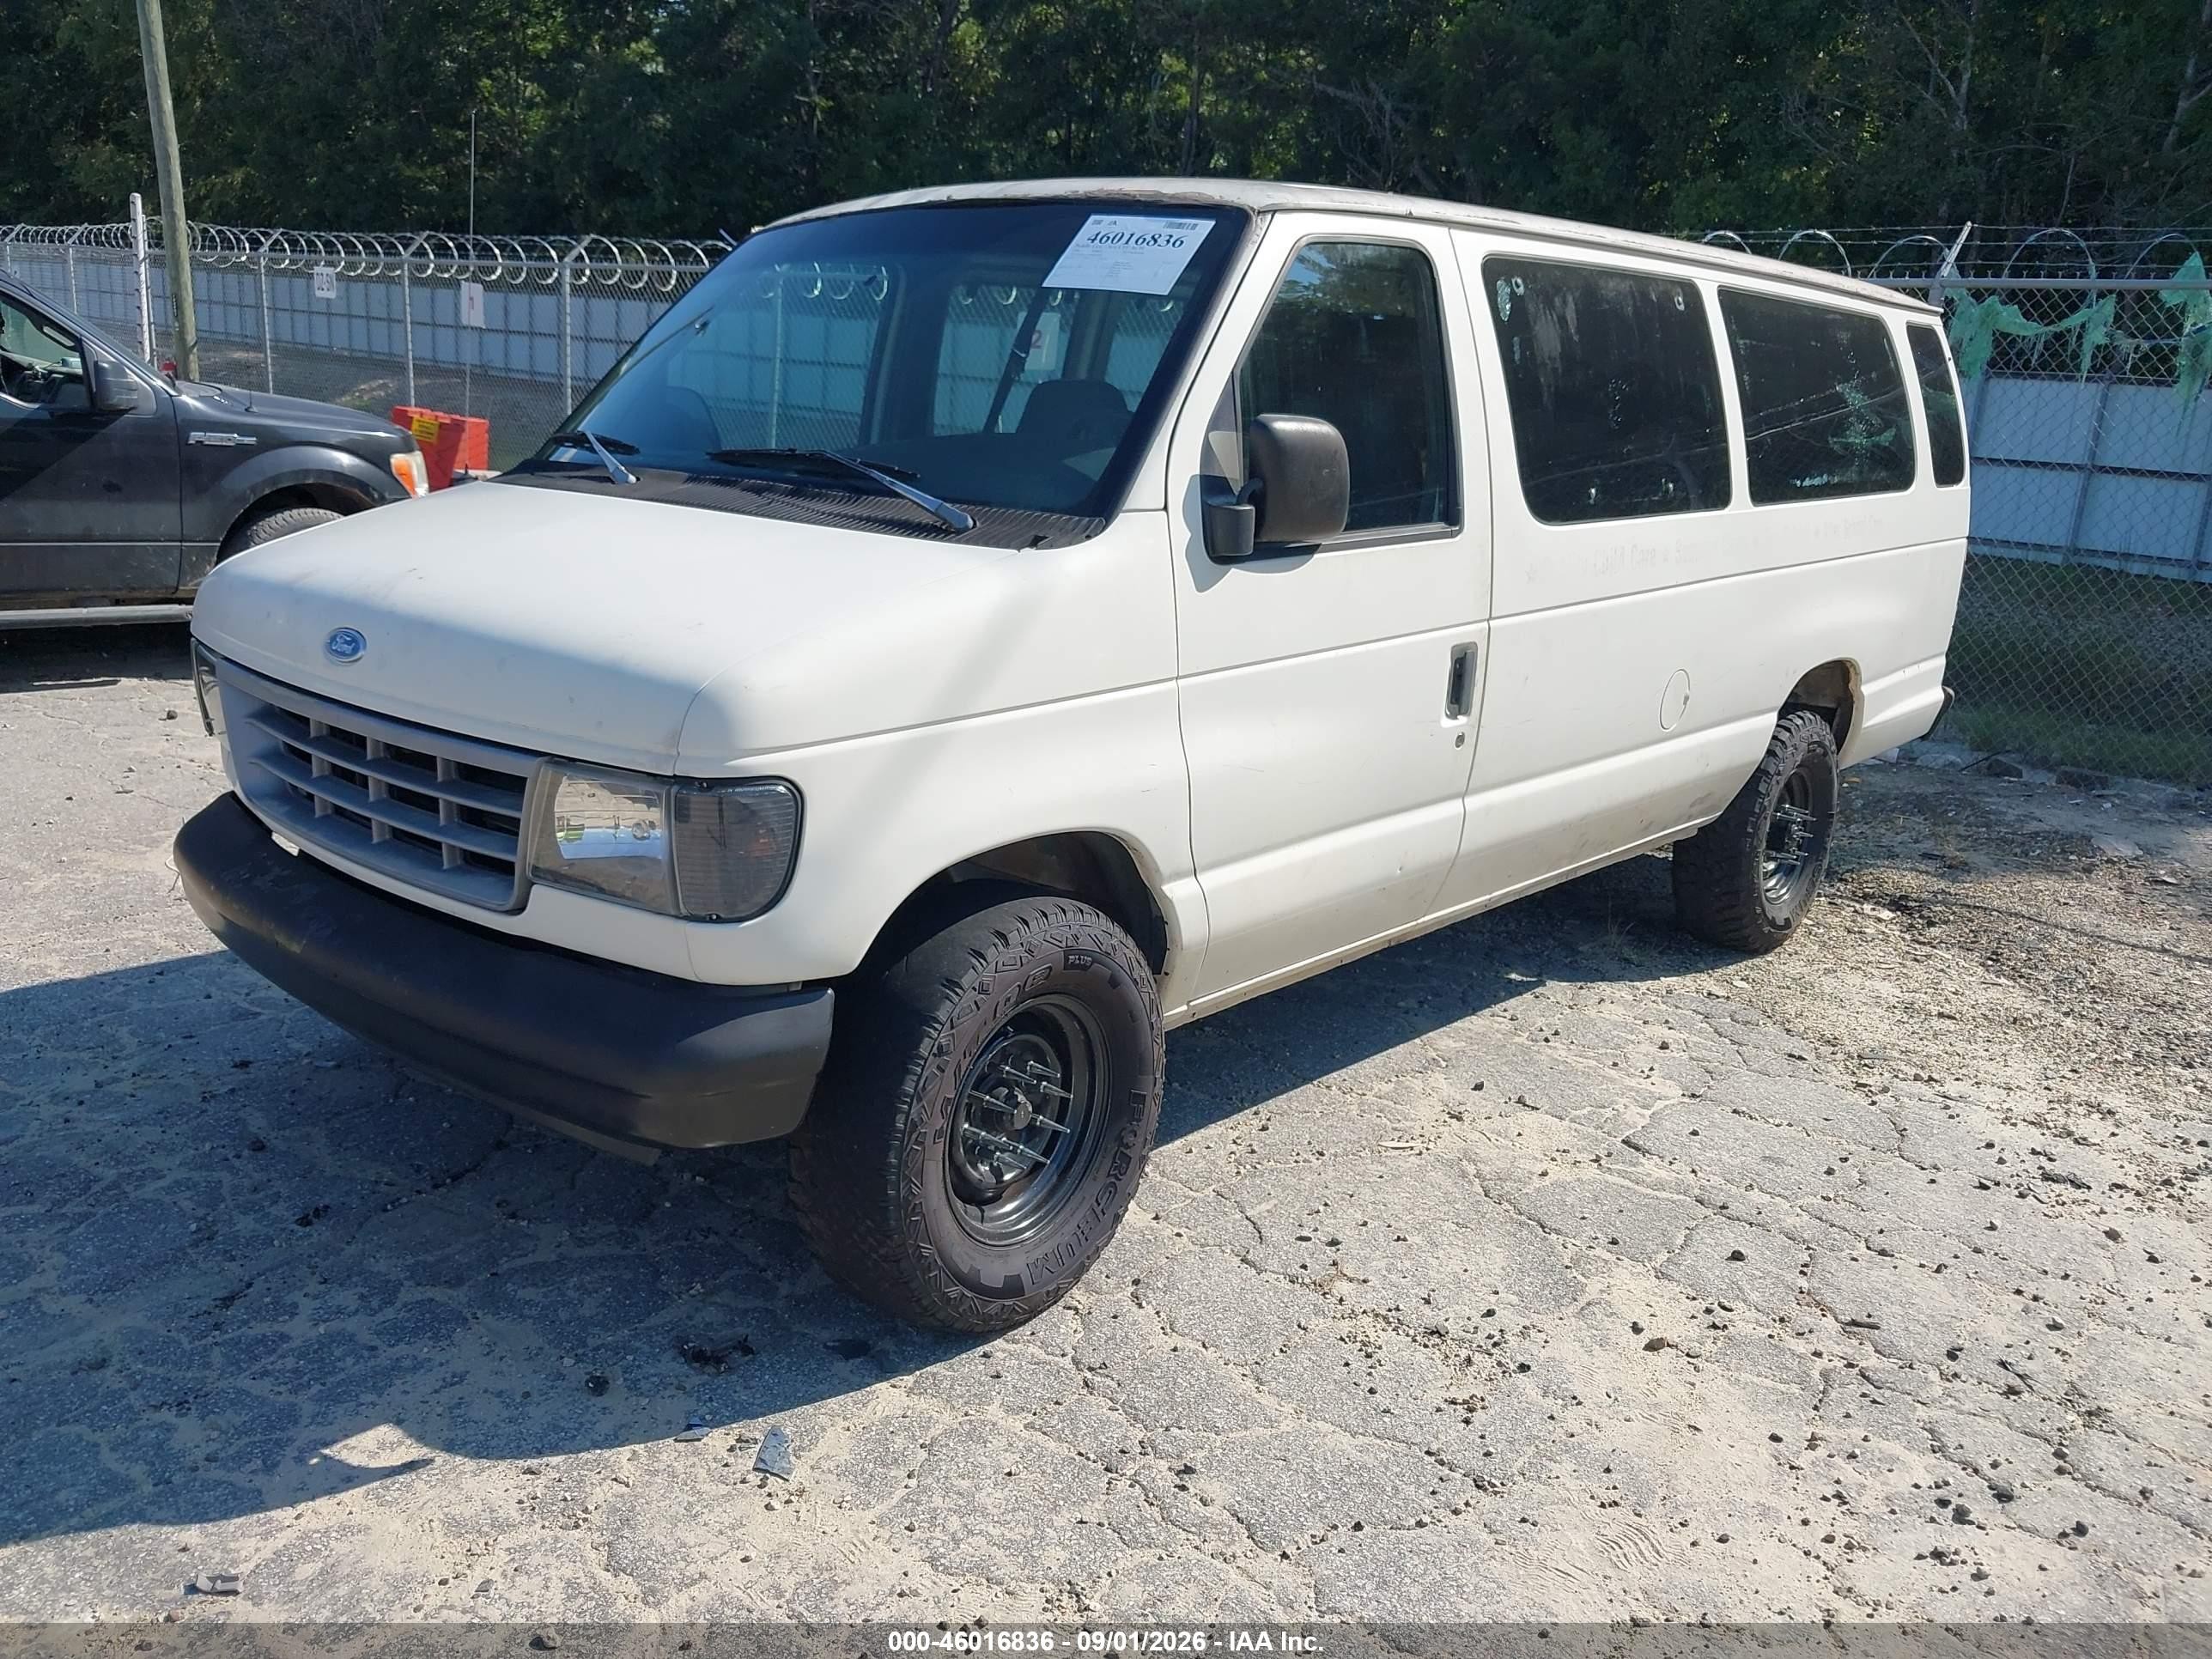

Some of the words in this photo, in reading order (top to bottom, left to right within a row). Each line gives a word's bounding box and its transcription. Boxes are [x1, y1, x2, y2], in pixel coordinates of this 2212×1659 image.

[1087, 231, 1187, 249] 46016836
[331, 633, 356, 653] Ford
[1067, 954, 1093, 967] PLUS
